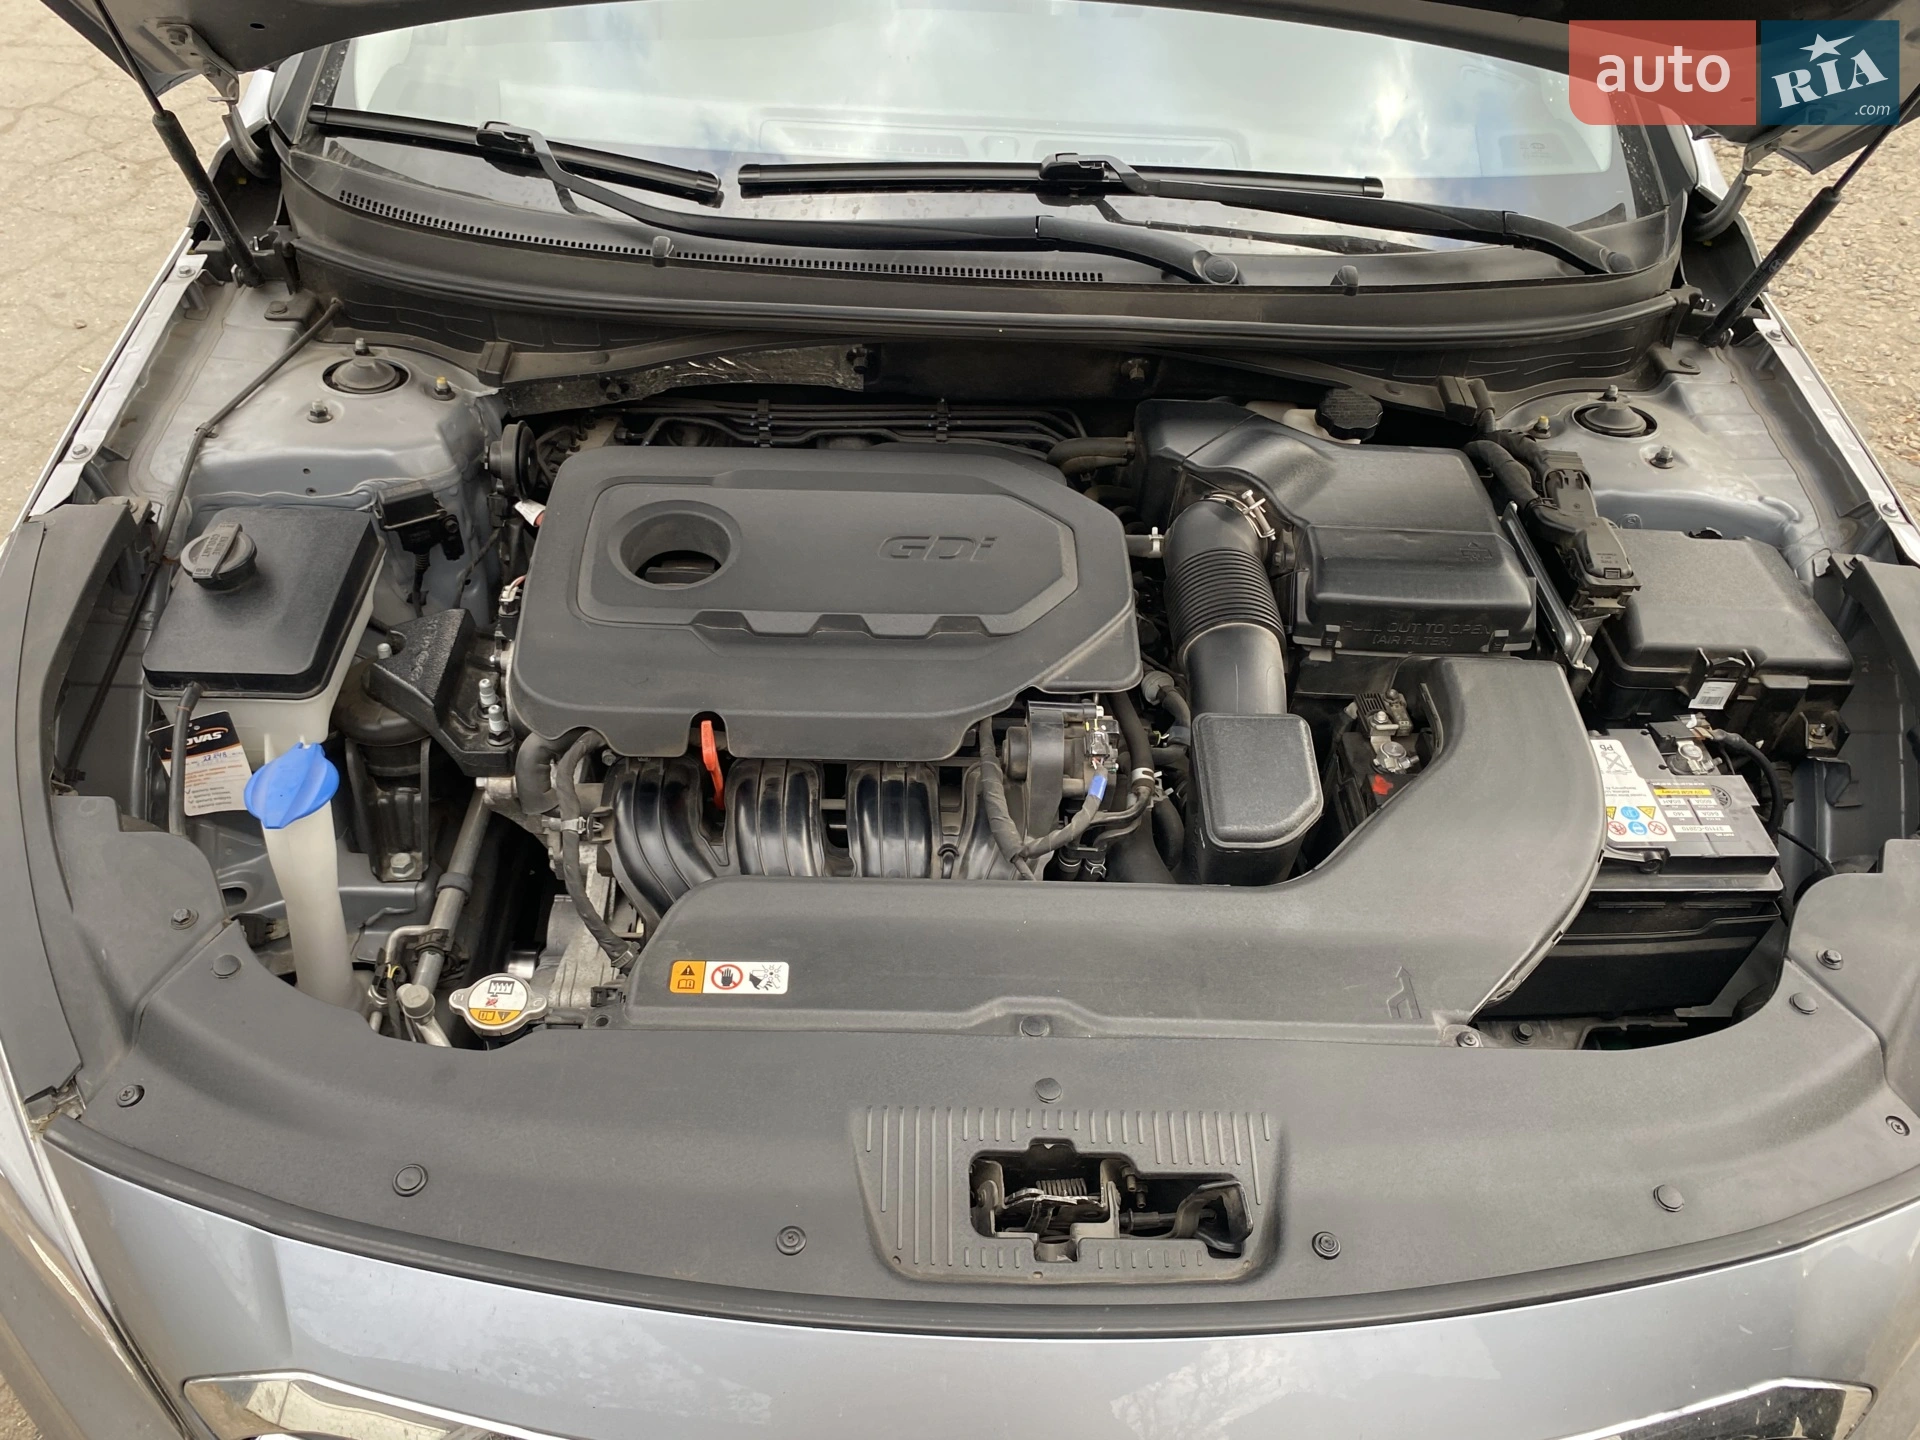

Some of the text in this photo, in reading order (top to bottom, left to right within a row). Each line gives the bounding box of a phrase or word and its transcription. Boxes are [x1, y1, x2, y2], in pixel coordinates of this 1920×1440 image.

[878, 535, 998, 561] GDi
[1387, 622, 1422, 633] OUT
[1425, 623, 1445, 634] TO
[1449, 624, 1492, 635] OPEN
